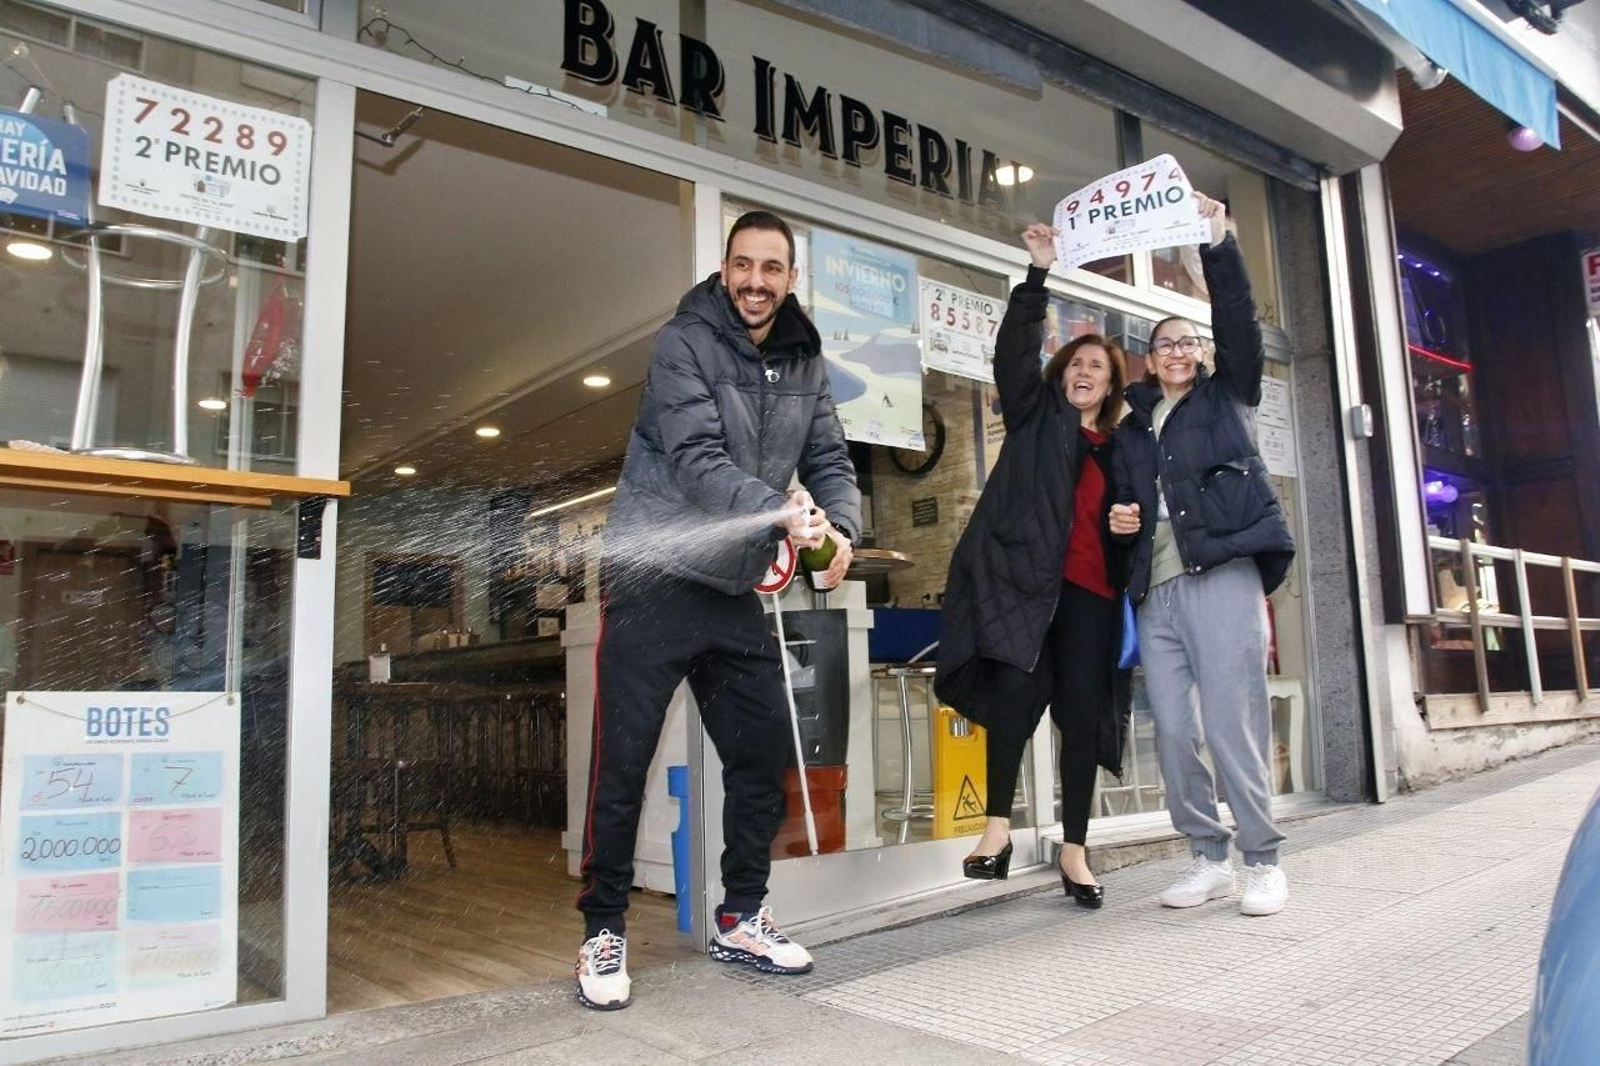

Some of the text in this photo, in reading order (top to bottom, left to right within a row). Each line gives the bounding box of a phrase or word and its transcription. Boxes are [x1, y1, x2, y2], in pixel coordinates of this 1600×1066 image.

[561, 0, 726, 122] BAR
[133, 96, 288, 157] 72289
[165, 140, 281, 186] PREMIO
[1066, 166, 1184, 214] 94974
[1088, 185, 1185, 224] PREMIO
[951, 291, 994, 317] PREMIO
[86, 706, 170, 738] BOTES
[46, 766, 94, 800] 54
[163, 765, 194, 795] 7
